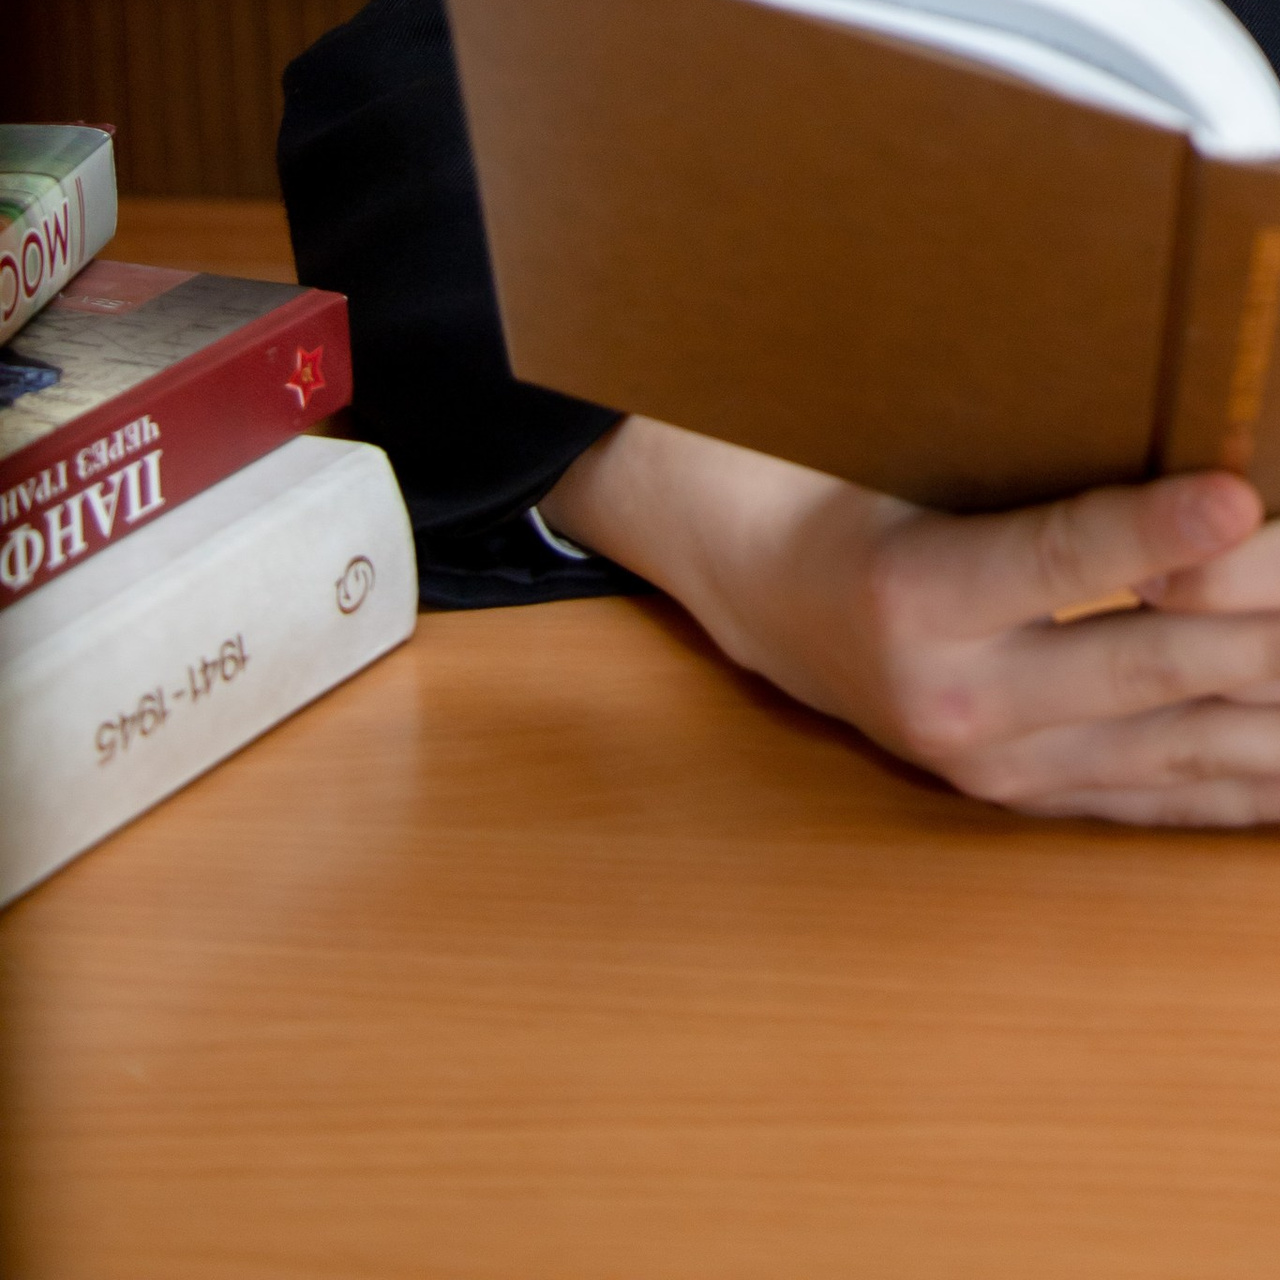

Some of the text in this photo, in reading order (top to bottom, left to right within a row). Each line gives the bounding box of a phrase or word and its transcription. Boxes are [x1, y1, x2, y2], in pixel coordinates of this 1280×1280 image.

[75, 414, 161, 480] ЧЕРЕЗ
[0, 448, 167, 592] ПАНФ
[95, 632, 252, 768] 1941-1945
